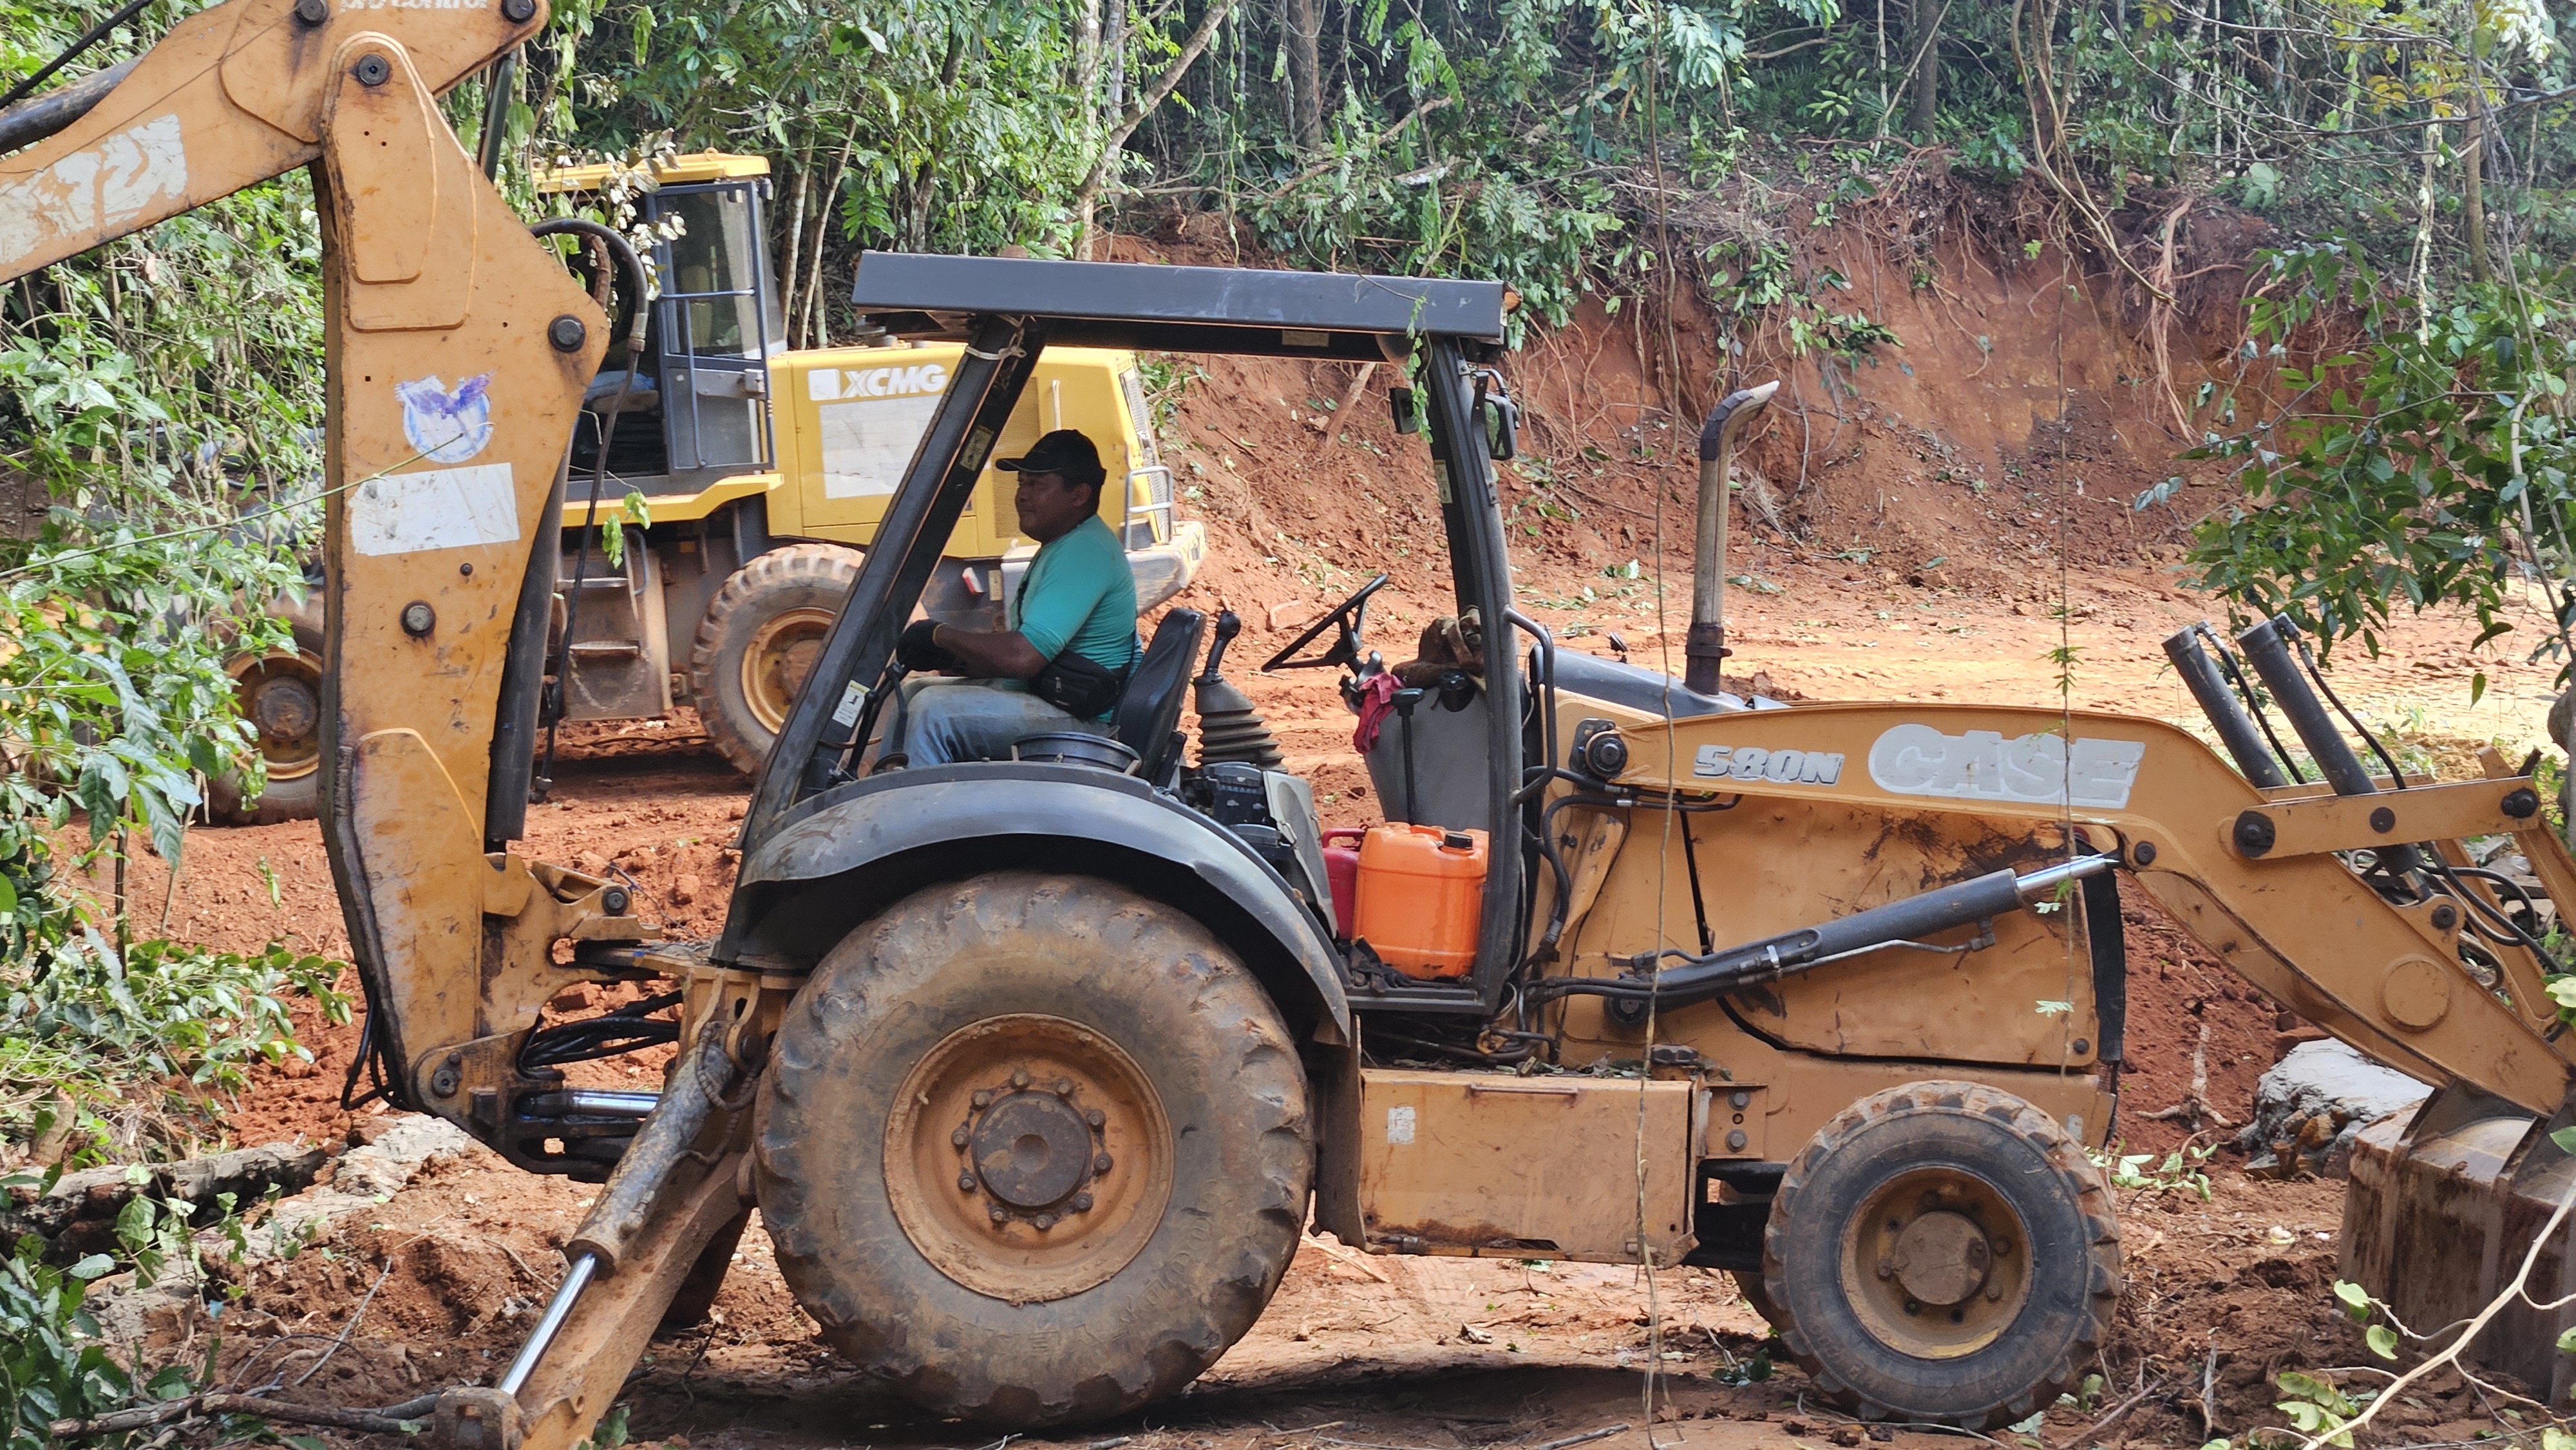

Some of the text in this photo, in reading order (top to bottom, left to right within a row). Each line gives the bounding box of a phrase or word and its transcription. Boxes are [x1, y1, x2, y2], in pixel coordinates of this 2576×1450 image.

[840, 364, 948, 397] XCMG
[1693, 723, 2146, 809] 580N CASE
